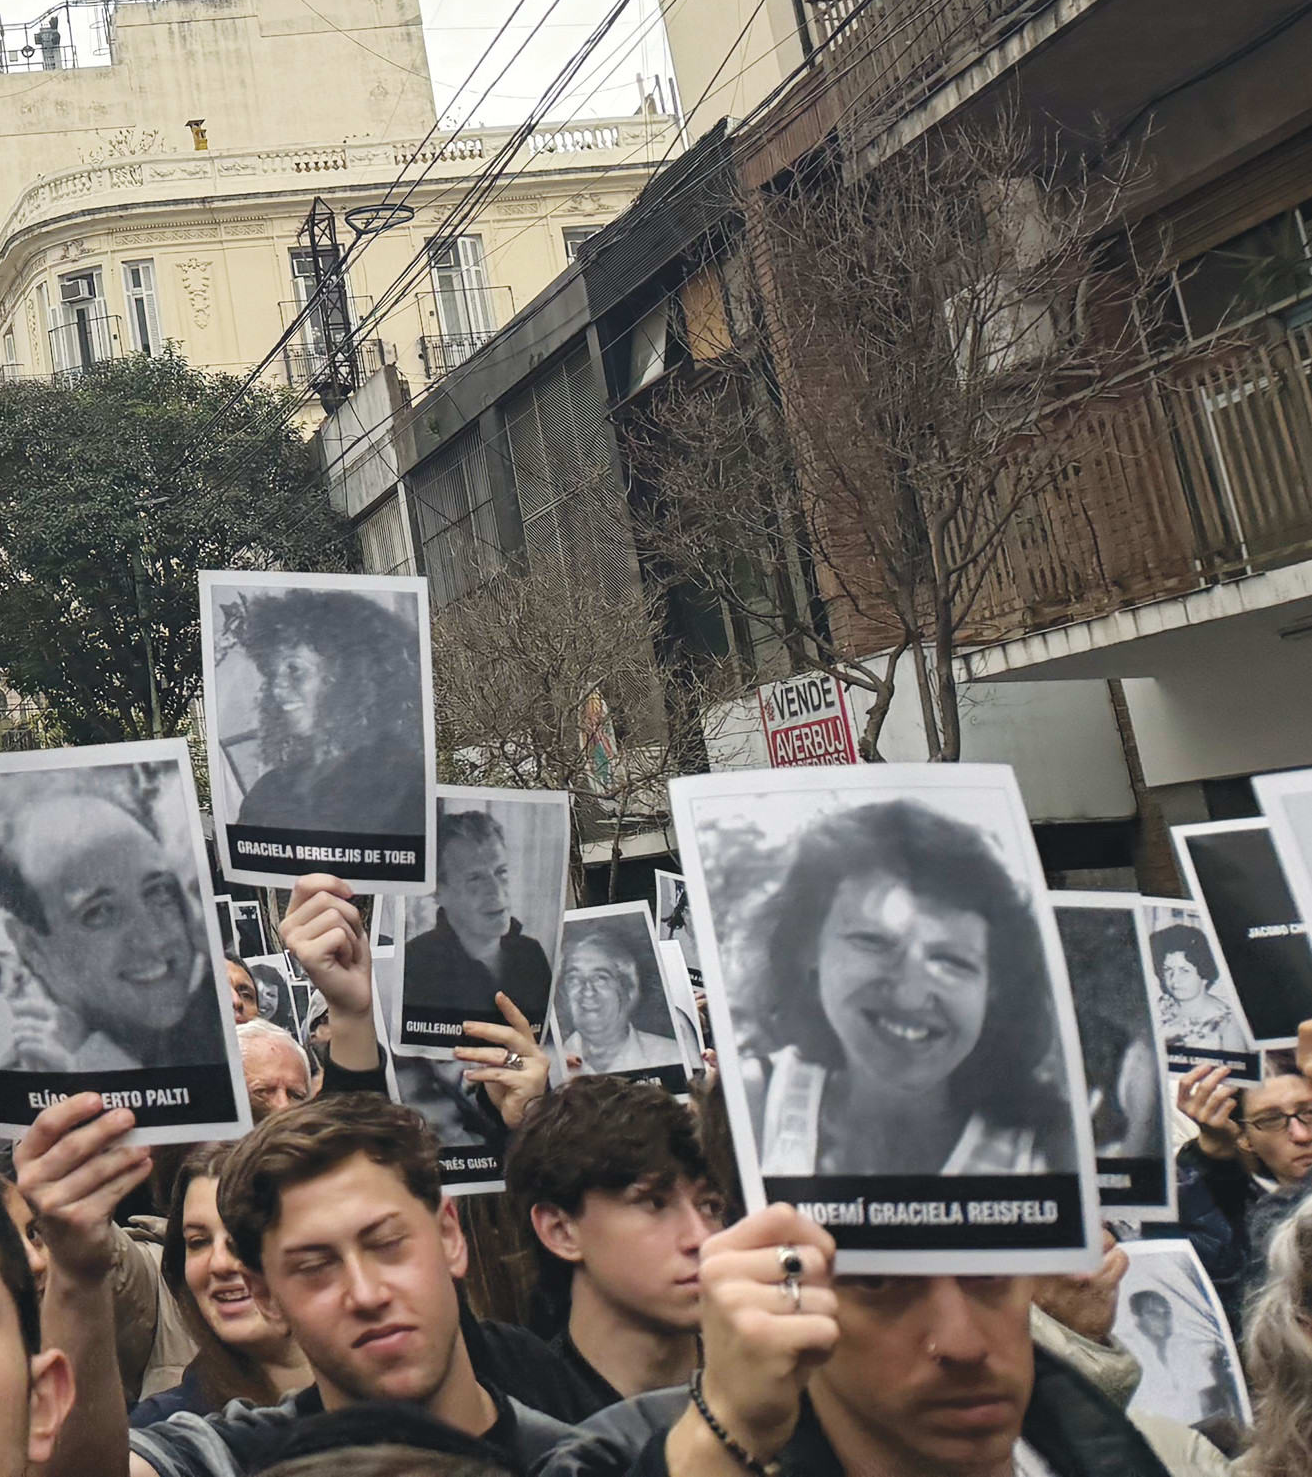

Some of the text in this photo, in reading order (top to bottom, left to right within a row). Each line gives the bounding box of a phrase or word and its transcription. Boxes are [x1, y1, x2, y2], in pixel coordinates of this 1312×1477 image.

[772, 675, 836, 721] VENDE
[775, 718, 846, 764] AVERBUJ
[237, 840, 416, 865] GRACIELA BERELEJIS DE TOER
[406, 1020, 463, 1036] GUILLERMO
[146, 1087, 190, 1107] PALTI
[868, 1201, 964, 1226] GRACIELA
[966, 1200, 1059, 1224] REISFELD
